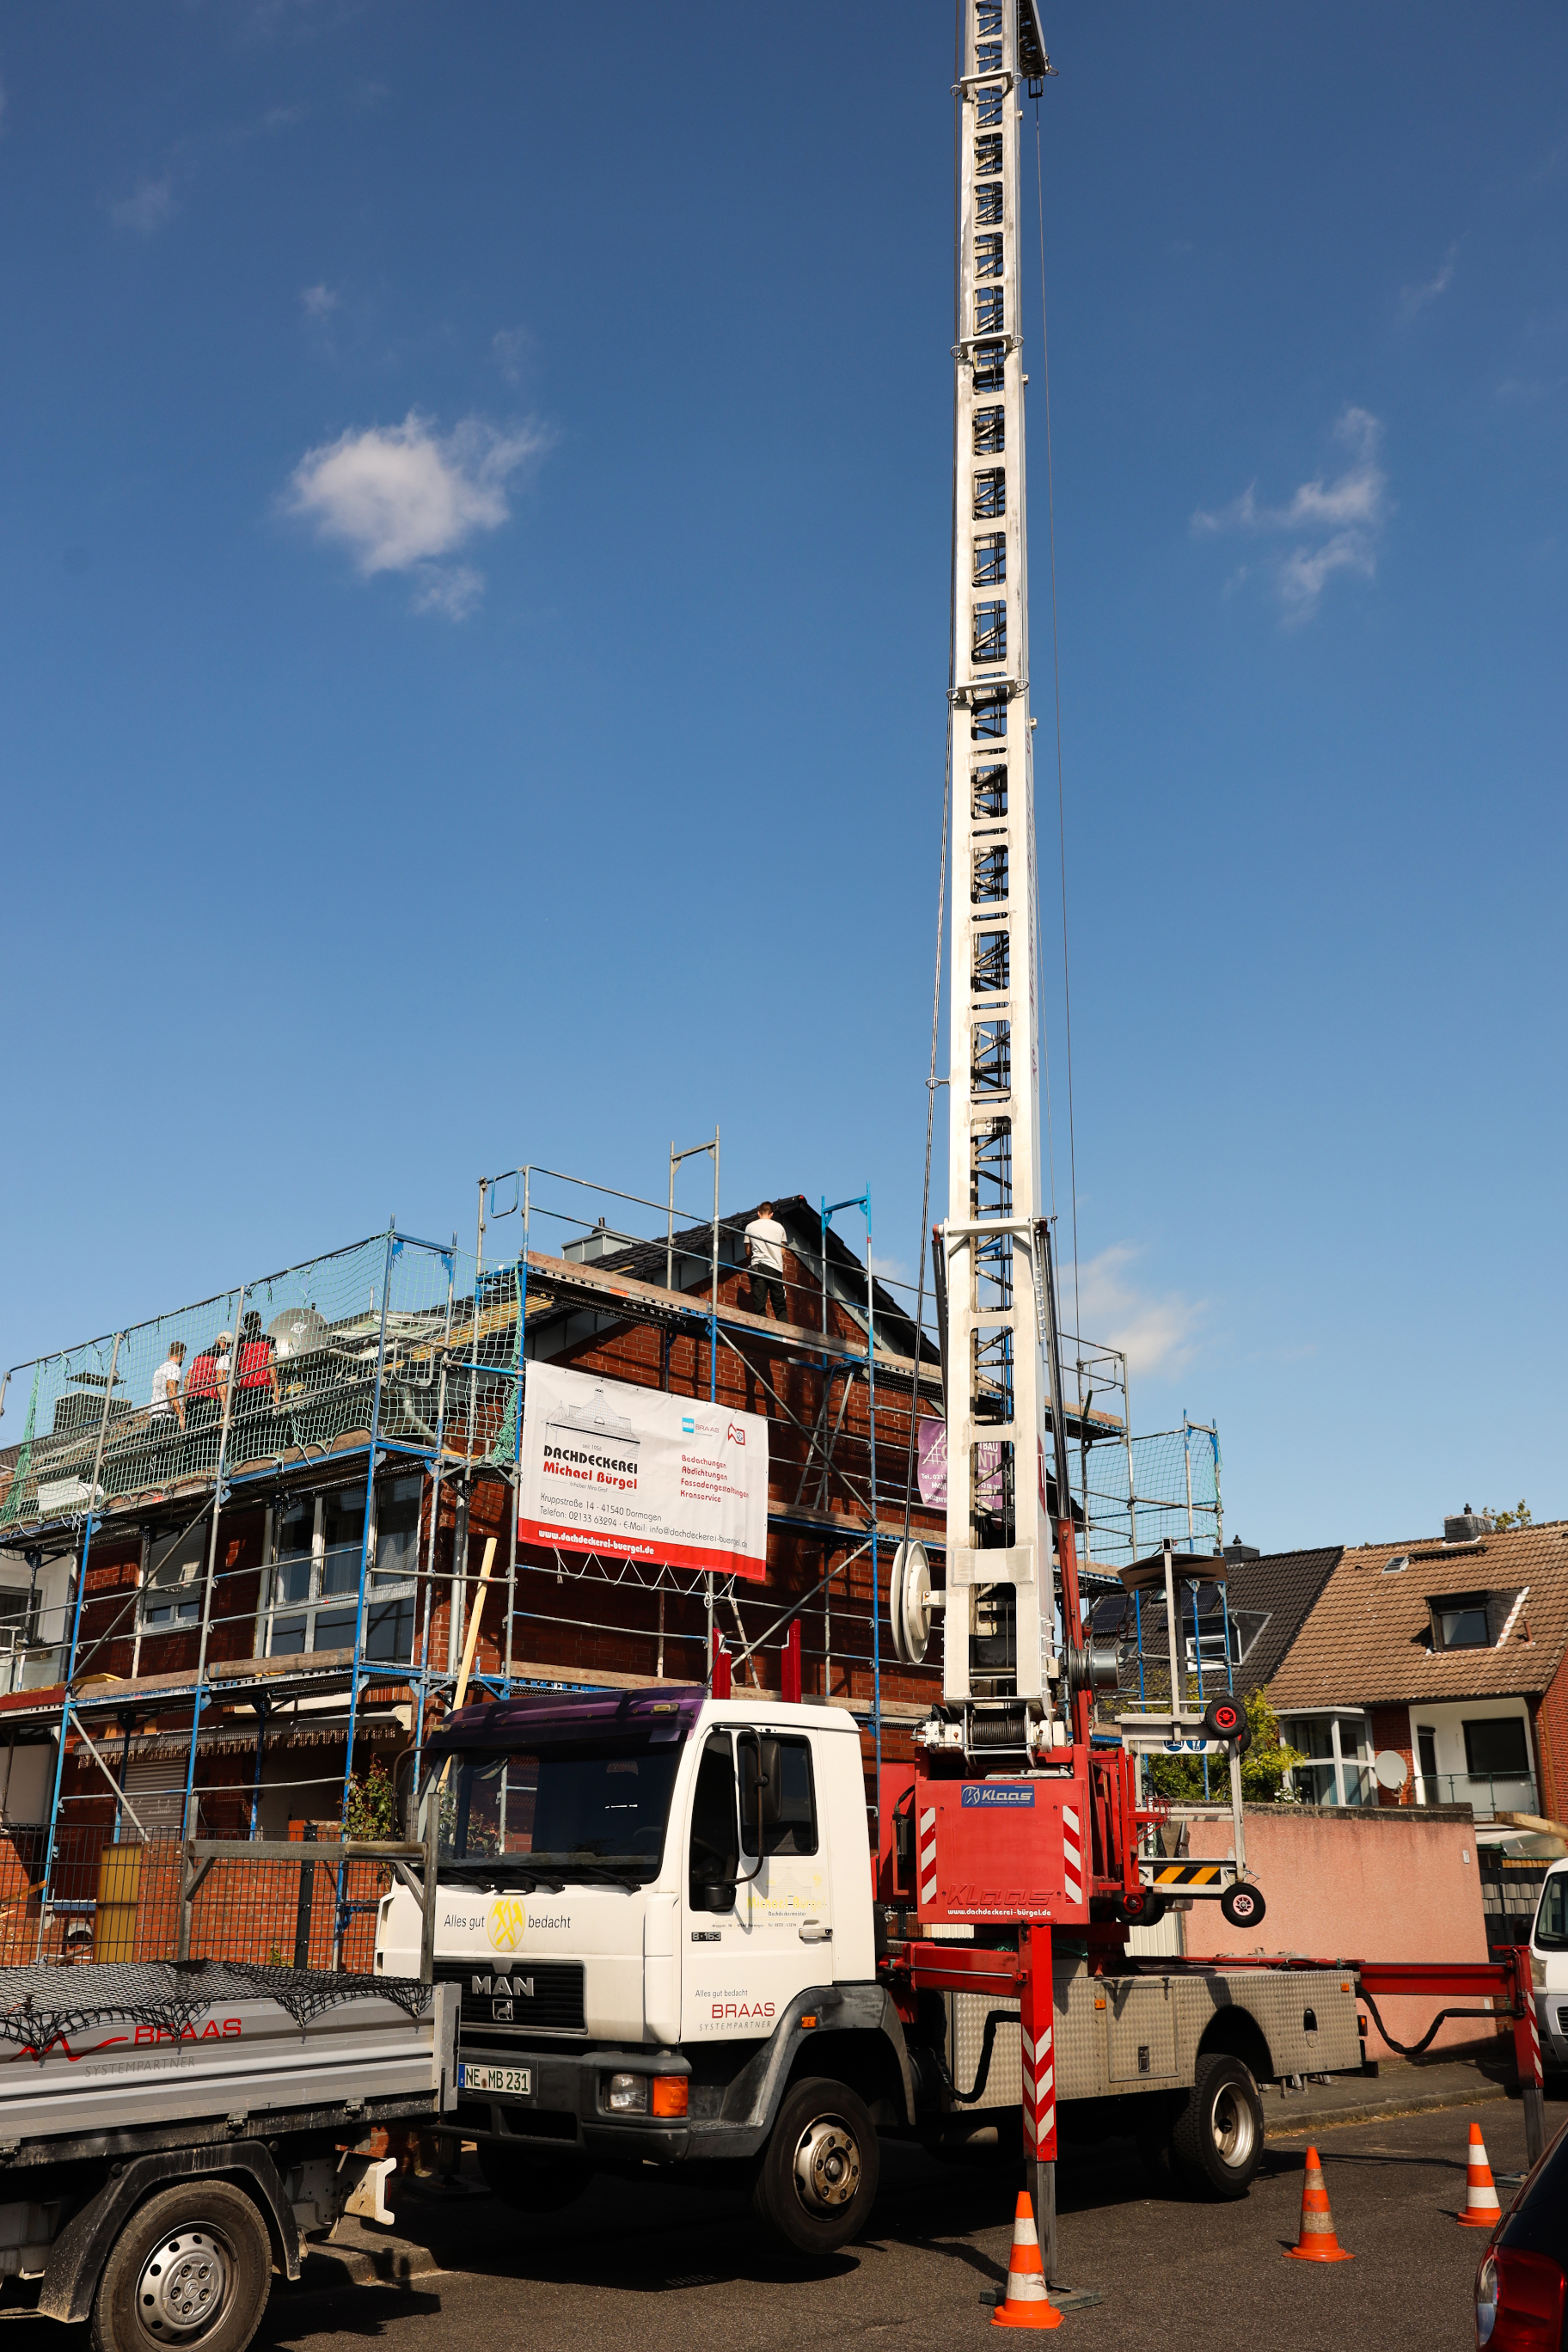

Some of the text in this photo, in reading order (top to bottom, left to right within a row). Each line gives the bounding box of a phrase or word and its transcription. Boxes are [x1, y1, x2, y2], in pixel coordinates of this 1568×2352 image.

[695, 1424, 720, 1434] BRAAS
[543, 1444, 638, 1474] DACHDECKEREI
[682, 1454, 727, 1469] Bedachungen
[543, 1461, 638, 1491] Michael Bürgel
[682, 1466, 728, 1481] Abdichtungen
[680, 1489, 722, 1503] Kranservice
[681, 1477, 750, 1498] Fassadengestaltungen
[540, 1492, 662, 1522] Kruppstraße 14 41540 Dormagen
[540, 1505, 748, 1548] Telefon: 02133 63294 E-Mail: info@dachdeckerei-buergel.de
[538, 1529, 655, 1555] www.dachdeckerei-buergel.de
[982, 1789, 1033, 1801] Klaas
[747, 1896, 788, 1909] Michael
[947, 1908, 1051, 1918] www.dachdeckerei-bürgel.de
[444, 1914, 572, 1931] Alles gut bedacht
[471, 1975, 535, 1997] MAN
[695, 1988, 748, 1999] Alles gut bedacht
[711, 2001, 775, 2019] BRAAS
[134, 2018, 242, 2046] BRAAS
[699, 2020, 771, 2031] SYSTEMPARTNER
[84, 2055, 196, 2078] SYSTEMPARTNER
[466, 2067, 481, 2087] NE
[488, 2069, 504, 2089] MB
[506, 2071, 529, 2092] 231
